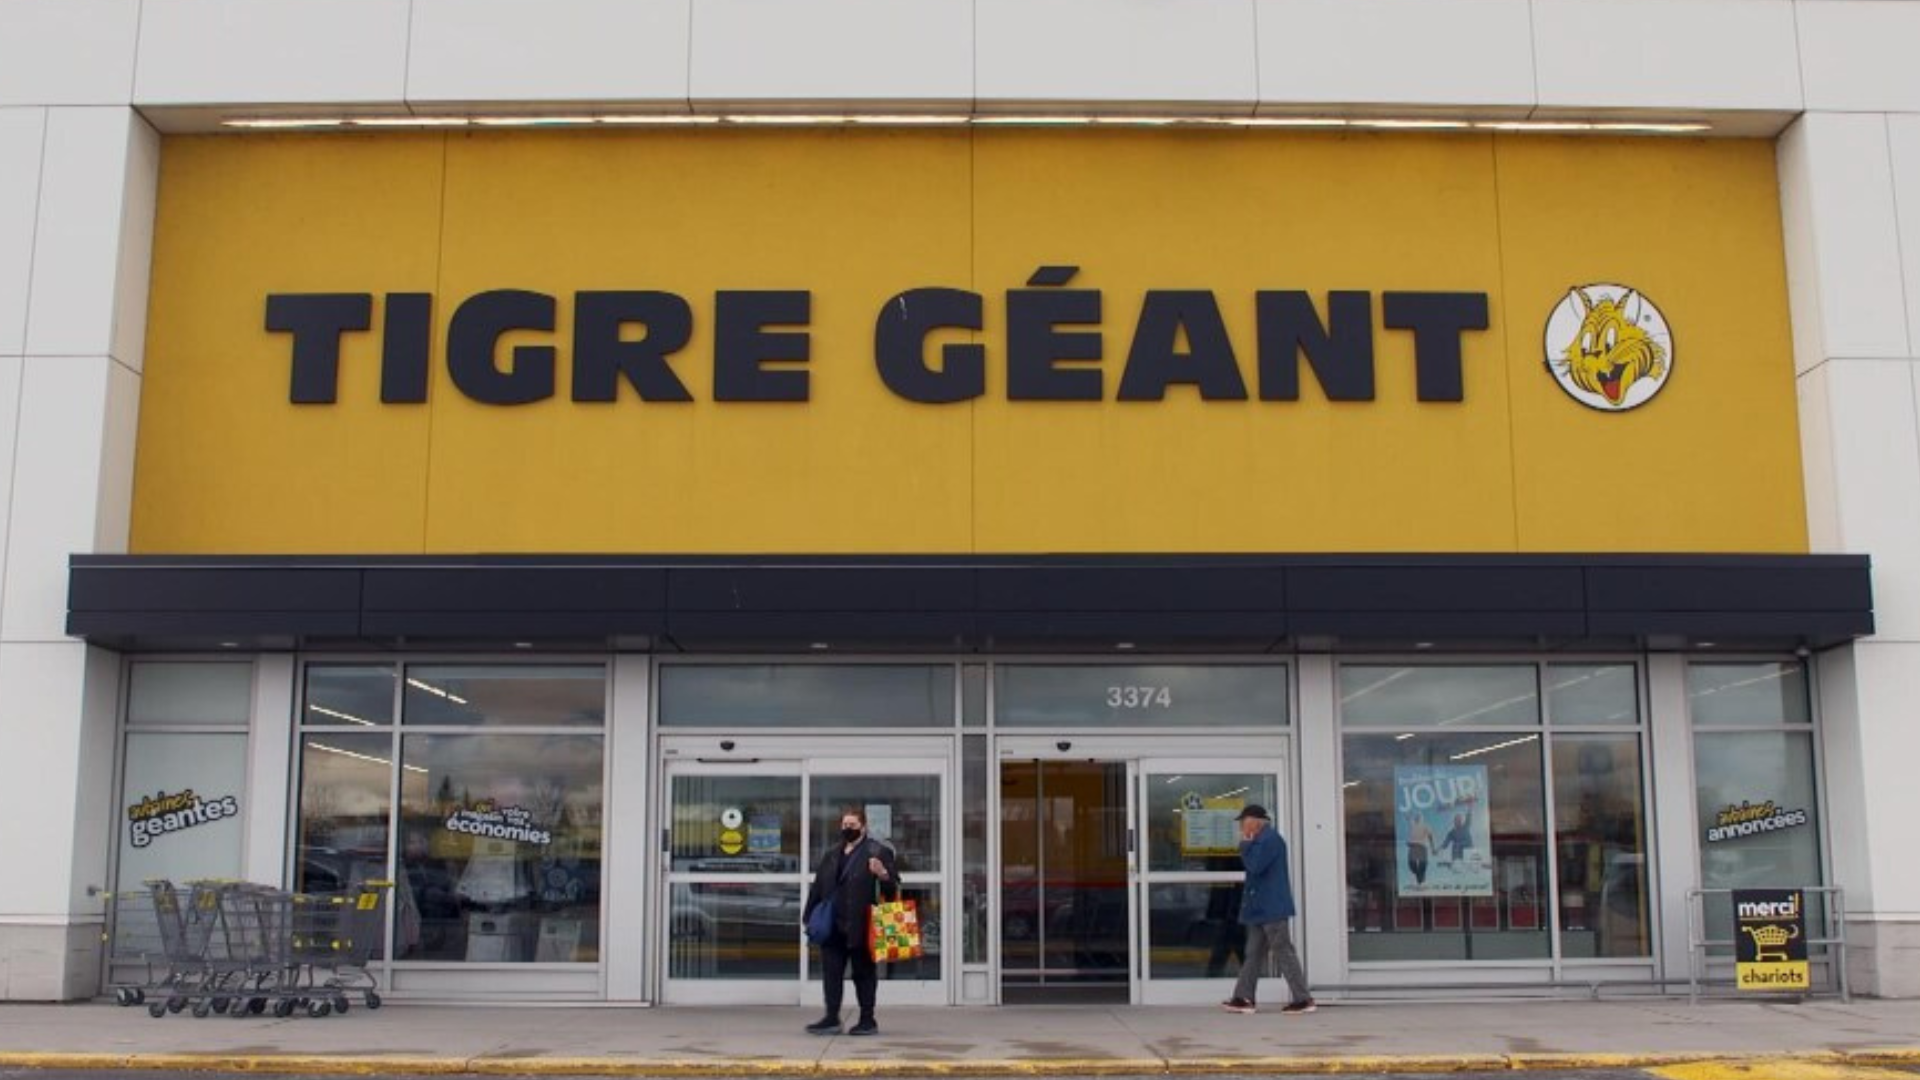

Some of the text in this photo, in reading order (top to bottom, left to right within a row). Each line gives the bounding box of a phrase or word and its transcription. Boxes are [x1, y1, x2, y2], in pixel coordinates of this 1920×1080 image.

[265, 266, 1489, 405] TIGRE GÉANT
[1106, 686, 1172, 708] 3374
[446, 812, 551, 843] économies
[1738, 892, 1799, 918] merci!
[1742, 968, 1804, 984] chariots
